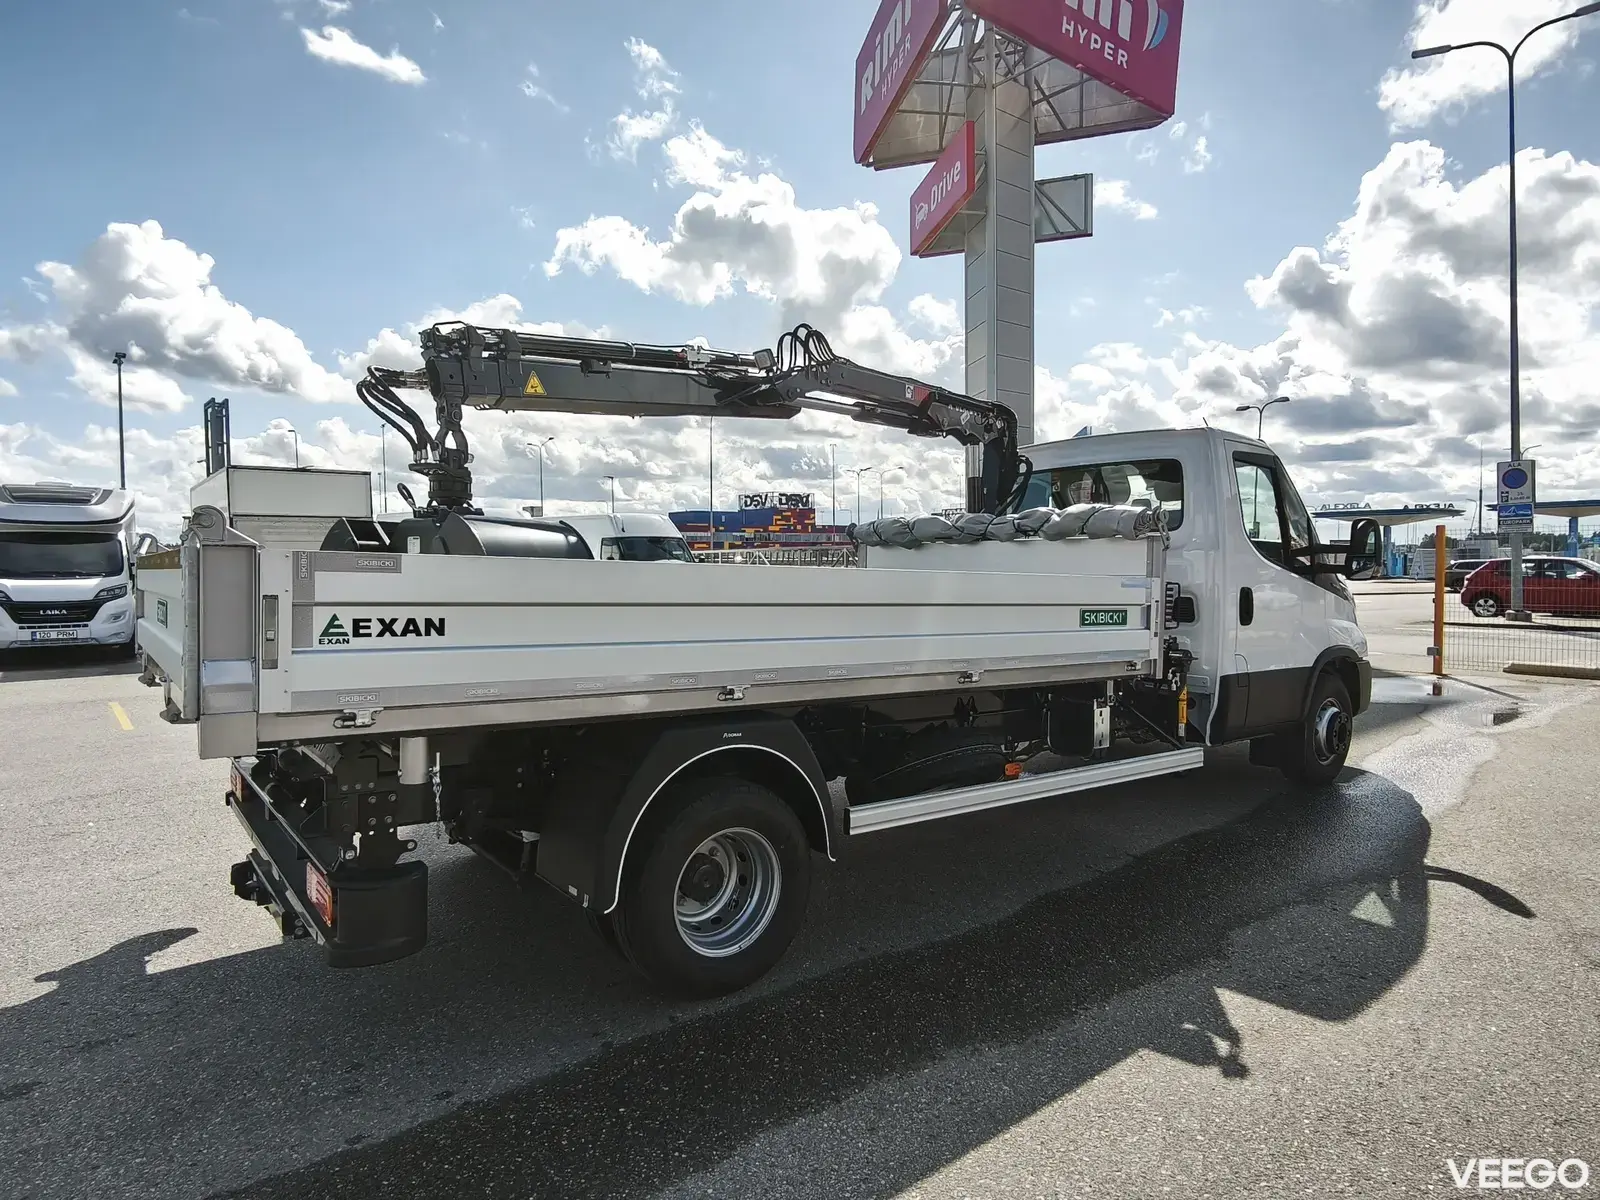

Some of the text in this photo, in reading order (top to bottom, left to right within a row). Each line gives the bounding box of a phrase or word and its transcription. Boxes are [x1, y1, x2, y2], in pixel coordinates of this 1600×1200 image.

[1061, 15, 1128, 70] HYPER
[881, 32, 911, 101] HYPER
[930, 160, 961, 212] Drive
[743, 493, 769, 508] DSV
[357, 559, 394, 567] SKIBICKI
[1084, 612, 1122, 623] SKIBICKI
[351, 617, 446, 638] EXAN
[338, 694, 376, 703] SKIBICKI
